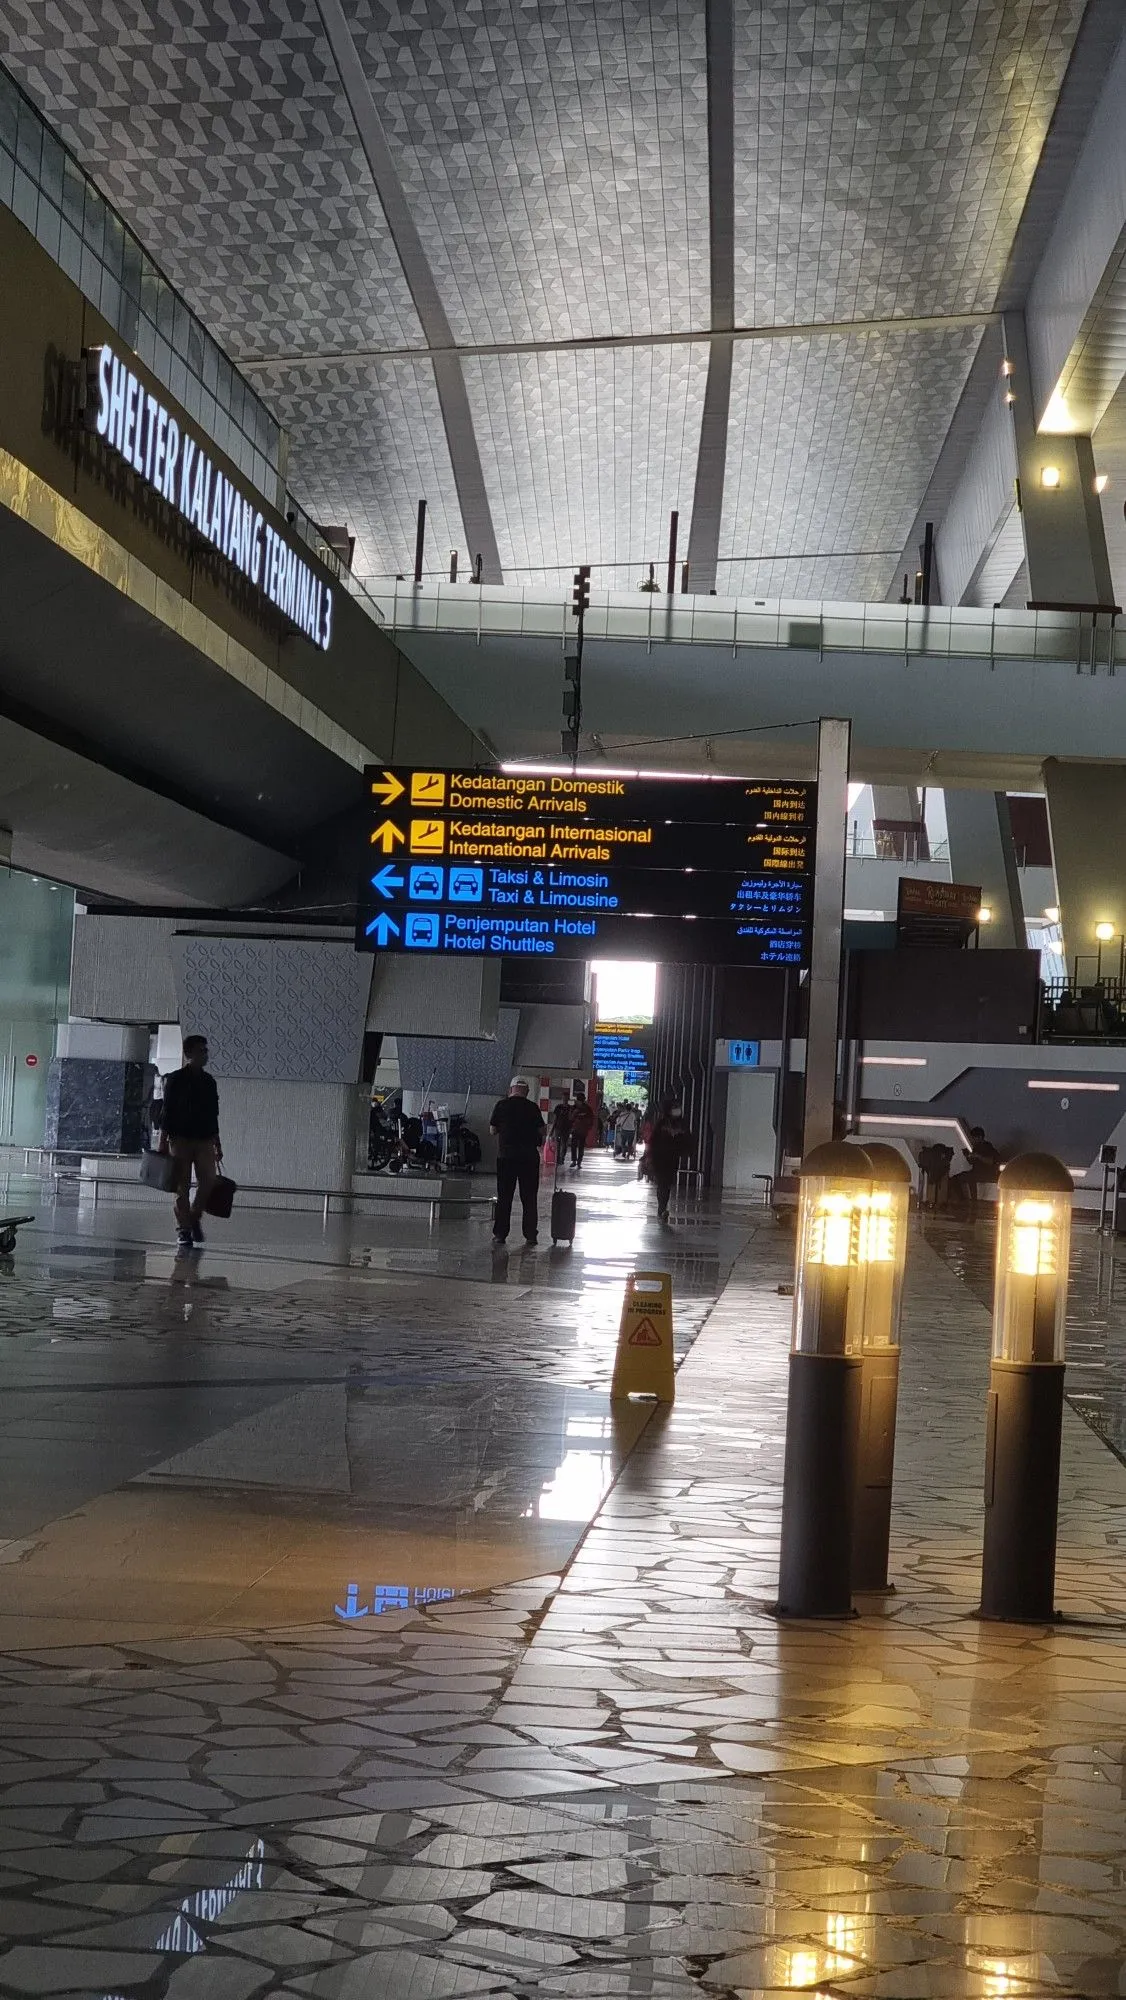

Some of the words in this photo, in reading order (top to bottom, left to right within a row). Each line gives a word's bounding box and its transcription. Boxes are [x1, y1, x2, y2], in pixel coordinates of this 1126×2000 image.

[97, 344, 179, 504] SHELTER
[179, 433, 263, 584] KALAYANG
[263, 523, 324, 647] TERMINAL
[323, 588, 332, 650] 3
[451, 774, 546, 794] Kedatangan
[551, 778, 625, 795] Domestik
[450, 793, 524, 810] Domestic
[527, 796, 587, 812] Arrivals
[773, 799, 806, 810] 国内到达
[450, 821, 545, 841] Kedatangan
[550, 824, 652, 843] Internasional
[449, 840, 546, 858] International
[550, 843, 610, 860] Arrivals
[773, 847, 805, 857] 国际到达
[489, 868, 528, 884] Taksi
[533, 871, 544, 885] &
[550, 871, 608, 888] Limosin
[488, 888, 519, 903] Taxi
[523, 890, 535, 904] &
[540, 891, 618, 908] Limousine
[445, 914, 549, 933] Penjemputan
[554, 918, 596, 935] Hotel
[444, 934, 486, 950] Hotel
[490, 935, 554, 953] Shuttles
[632, 1301, 663, 1309] CLEANING
[635, 1308, 666, 1316] PROGRESS
